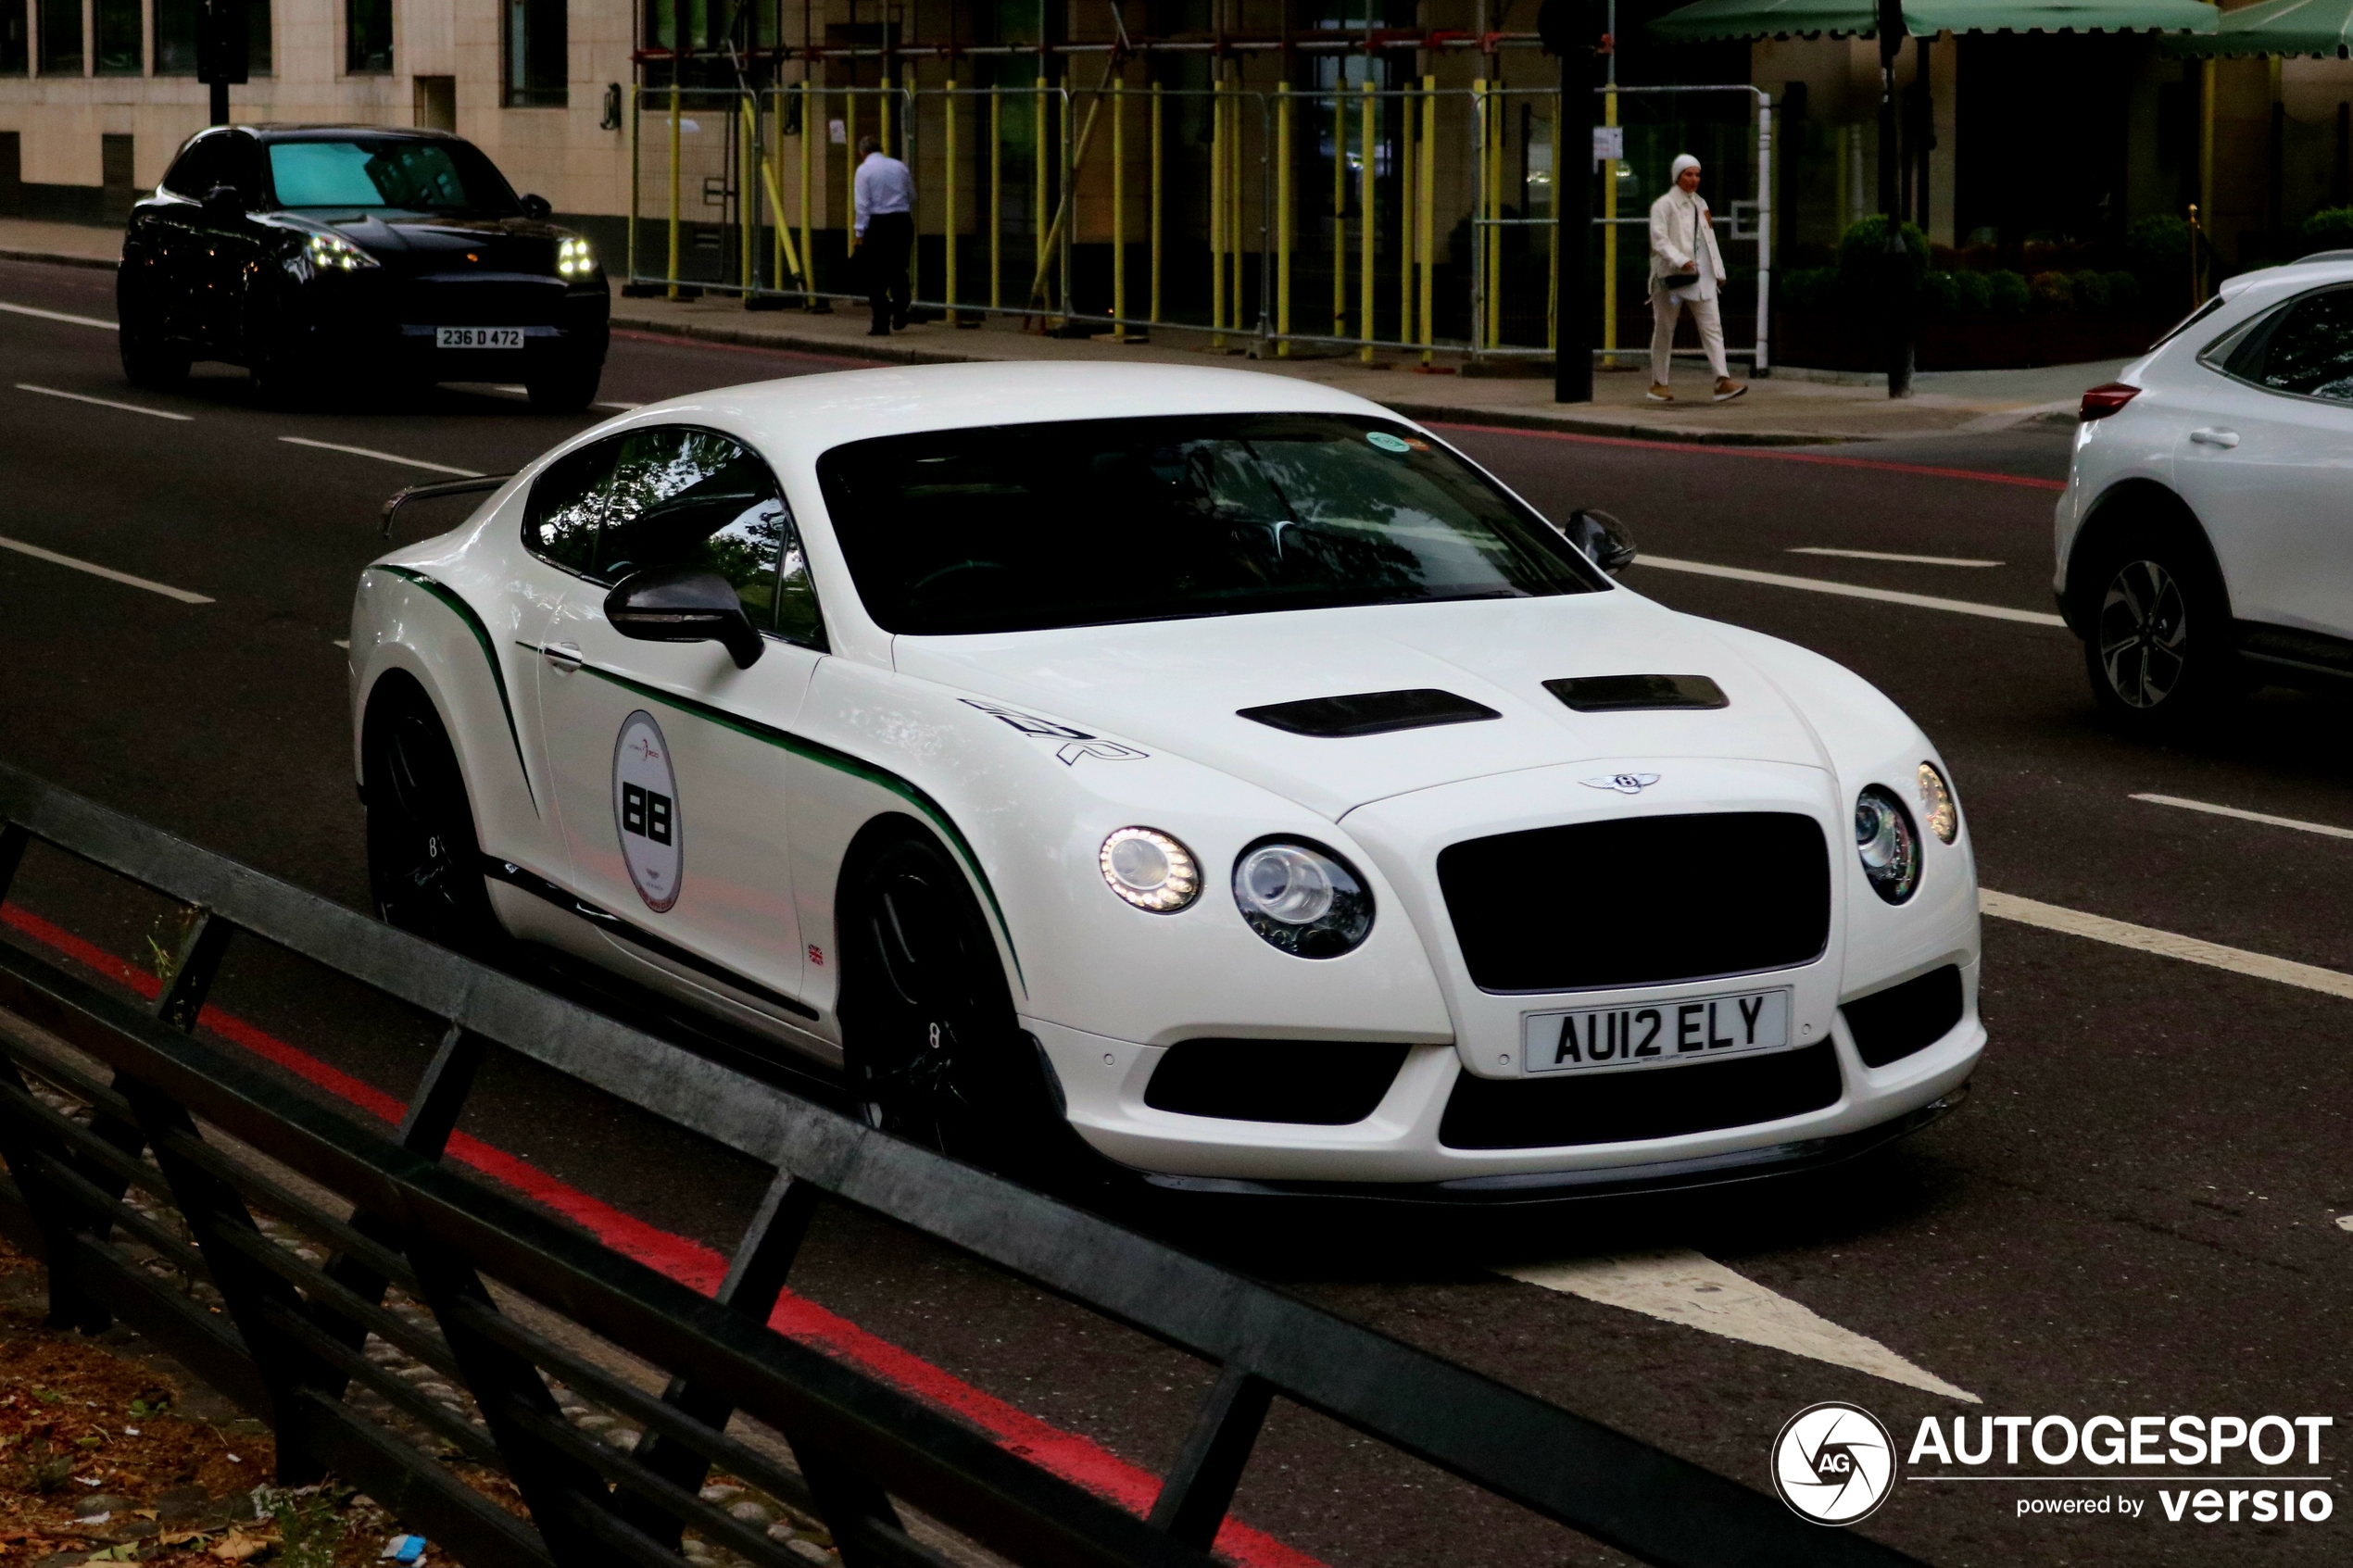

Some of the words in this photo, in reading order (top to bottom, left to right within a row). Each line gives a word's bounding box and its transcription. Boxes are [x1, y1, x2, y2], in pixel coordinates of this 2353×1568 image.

[443, 331, 472, 345] 236
[477, 331, 486, 345] D
[491, 331, 519, 345] 472
[623, 782, 671, 847] 88
[1554, 1010, 1661, 1064] AU12
[1678, 997, 1763, 1052] ELY
